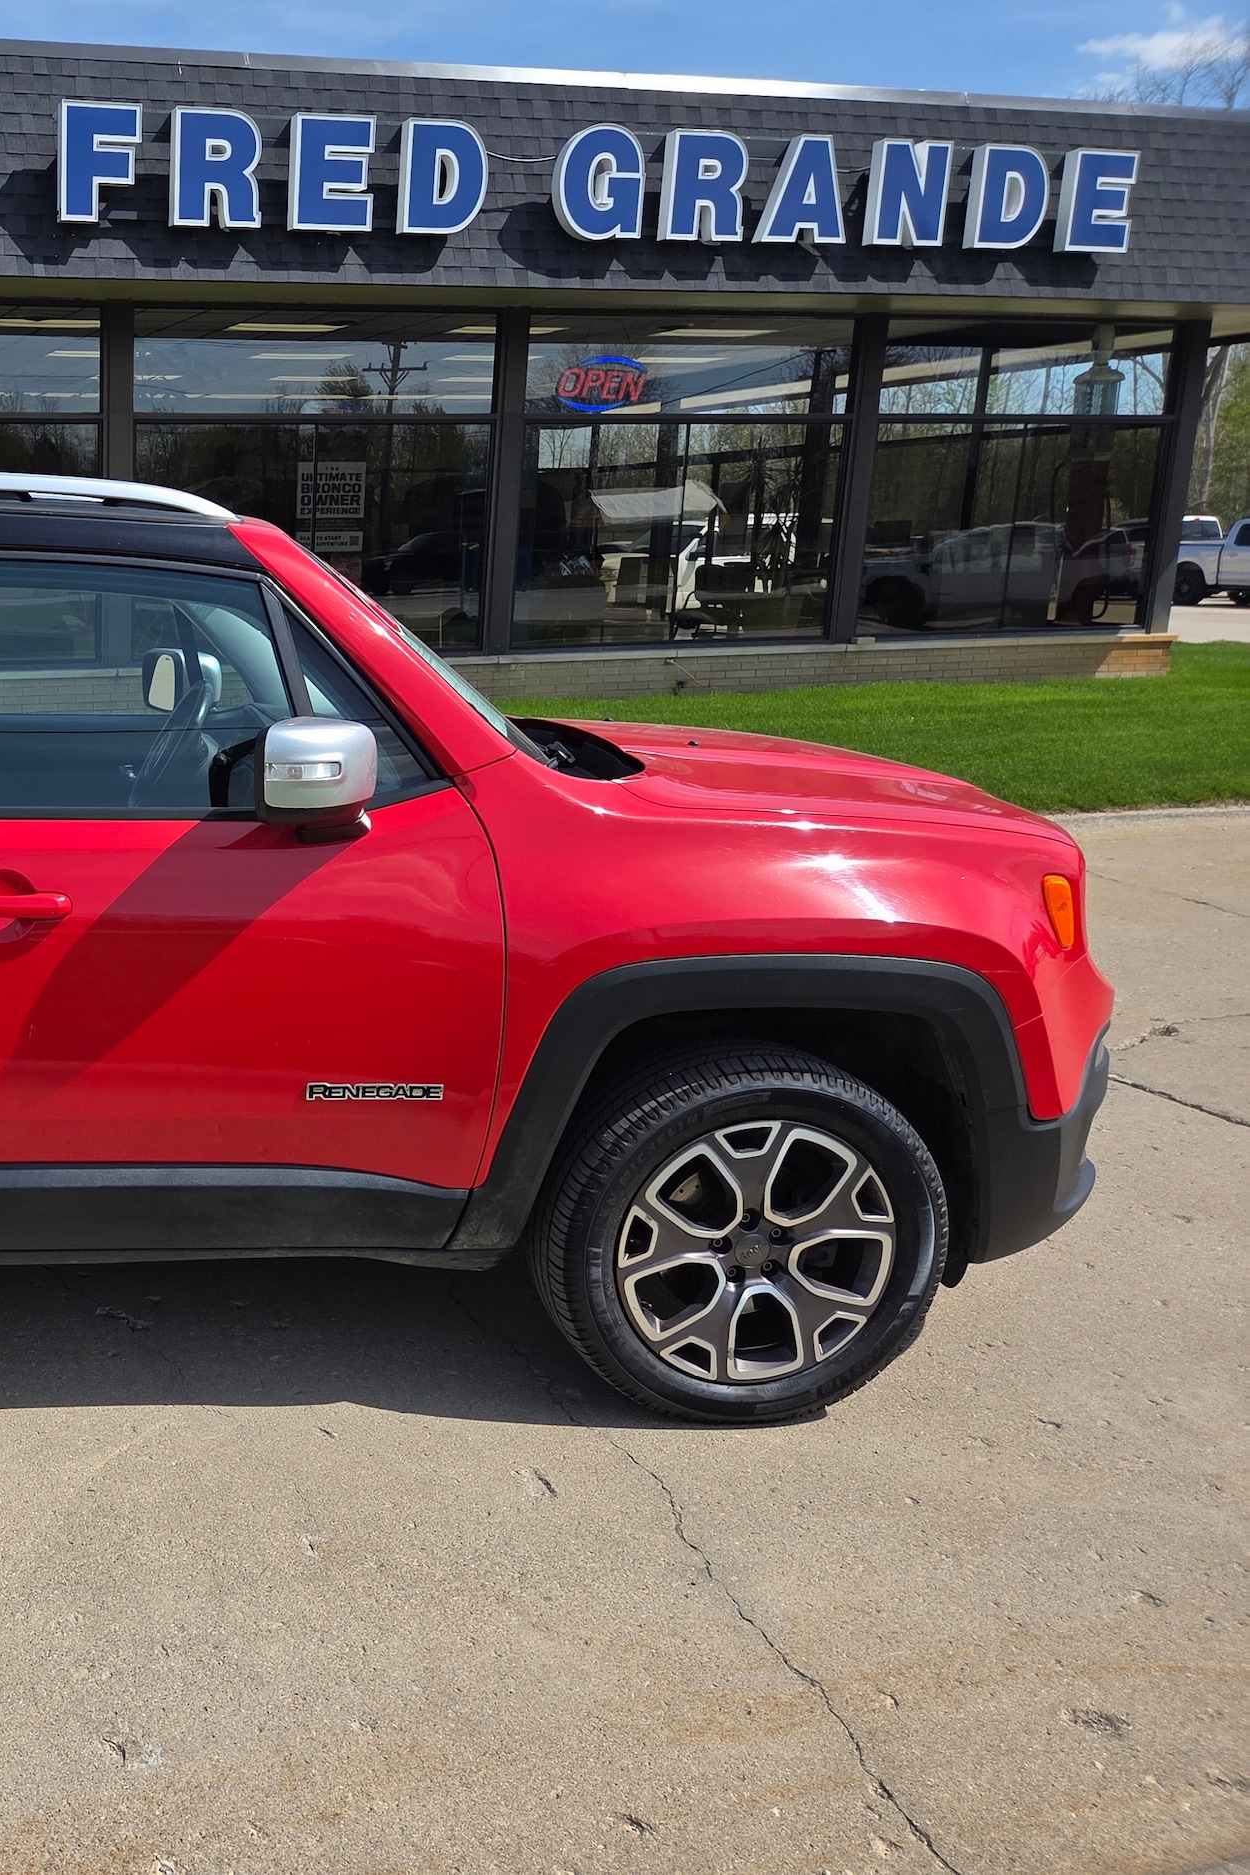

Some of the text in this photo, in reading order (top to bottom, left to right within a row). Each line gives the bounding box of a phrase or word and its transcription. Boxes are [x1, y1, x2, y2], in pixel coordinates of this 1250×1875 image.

[58, 98, 1141, 254] FRED GRANDE
[557, 367, 647, 402] OPEN
[301, 495, 361, 506] OWNER
[617, 1113, 700, 1187] MICHELIN
